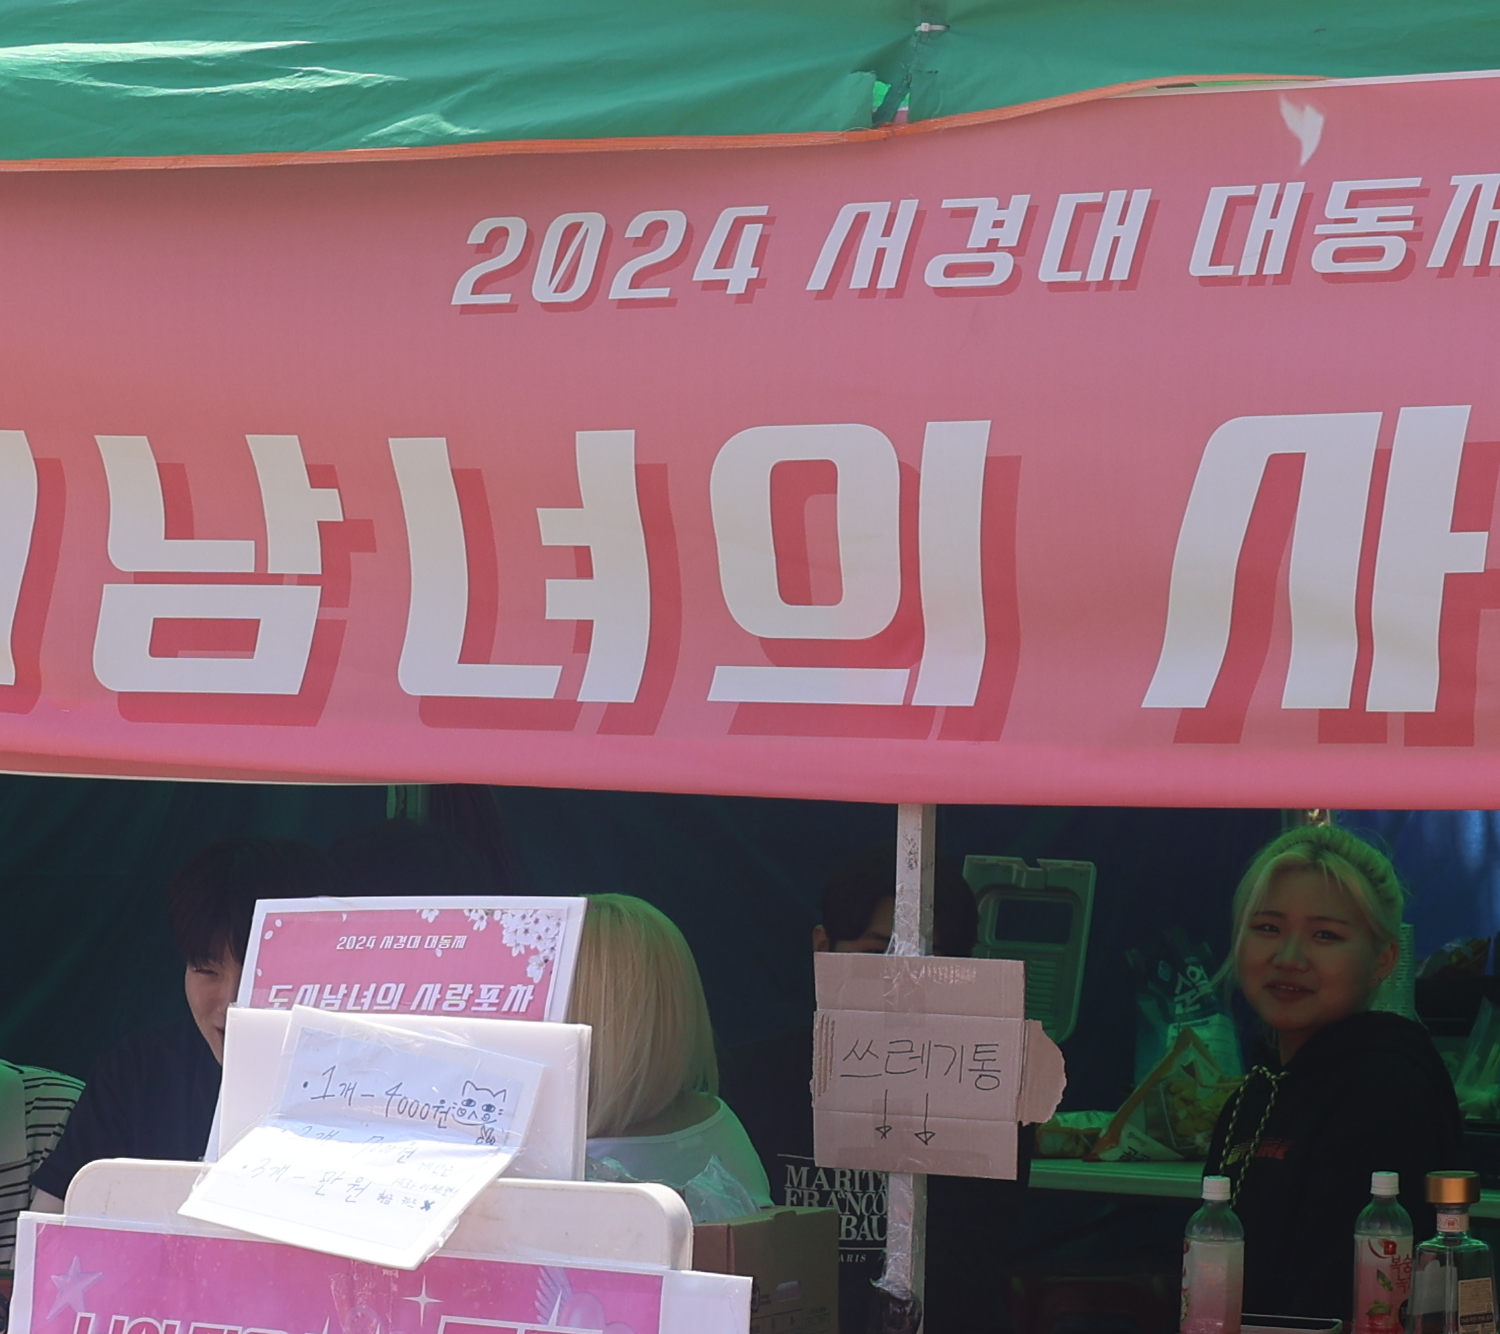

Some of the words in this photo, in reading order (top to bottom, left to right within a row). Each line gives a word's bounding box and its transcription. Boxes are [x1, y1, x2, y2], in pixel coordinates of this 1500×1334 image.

[450, 204, 772, 312] 2024
[806, 189, 1156, 299] 서경대
[336, 935, 376, 950] 2024
[379, 935, 420, 950] 서경대
[424, 934, 468, 950] 대동제
[409, 982, 535, 1013] 사랑포차
[840, 1039, 1001, 1090] 쓰레기통
[310, 1065, 355, 1106] 1개
[383, 1081, 452, 1129] 4000원
[784, 1164, 888, 1193] MARIT
[839, 1254, 867, 1263] ARIS
[1391, 1255, 1412, 1274] 복숭
